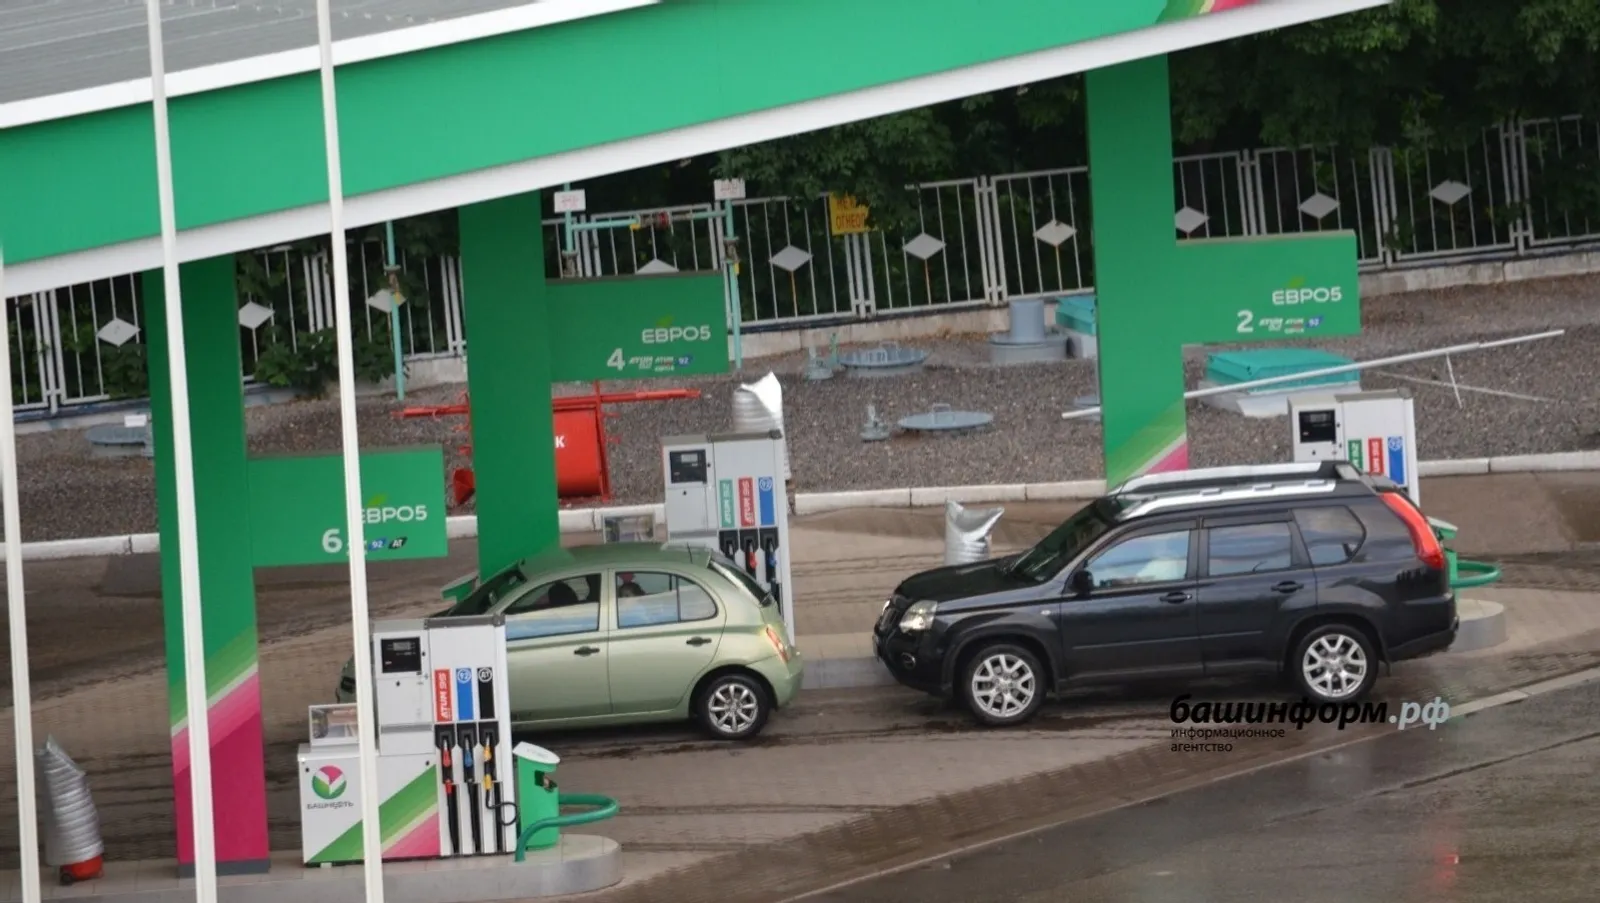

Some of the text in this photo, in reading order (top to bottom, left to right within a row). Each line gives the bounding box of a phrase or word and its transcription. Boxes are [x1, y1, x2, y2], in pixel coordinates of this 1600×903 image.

[1271, 286, 1342, 306] ЕВРО5
[1236, 309, 1253, 333] 2
[641, 325, 711, 344] ЕВРО5
[606, 347, 625, 372] 4
[321, 528, 343, 554] 6
[371, 540, 384, 549] 92
[439, 673, 446, 689] 95
[440, 691, 449, 719] ATUM
